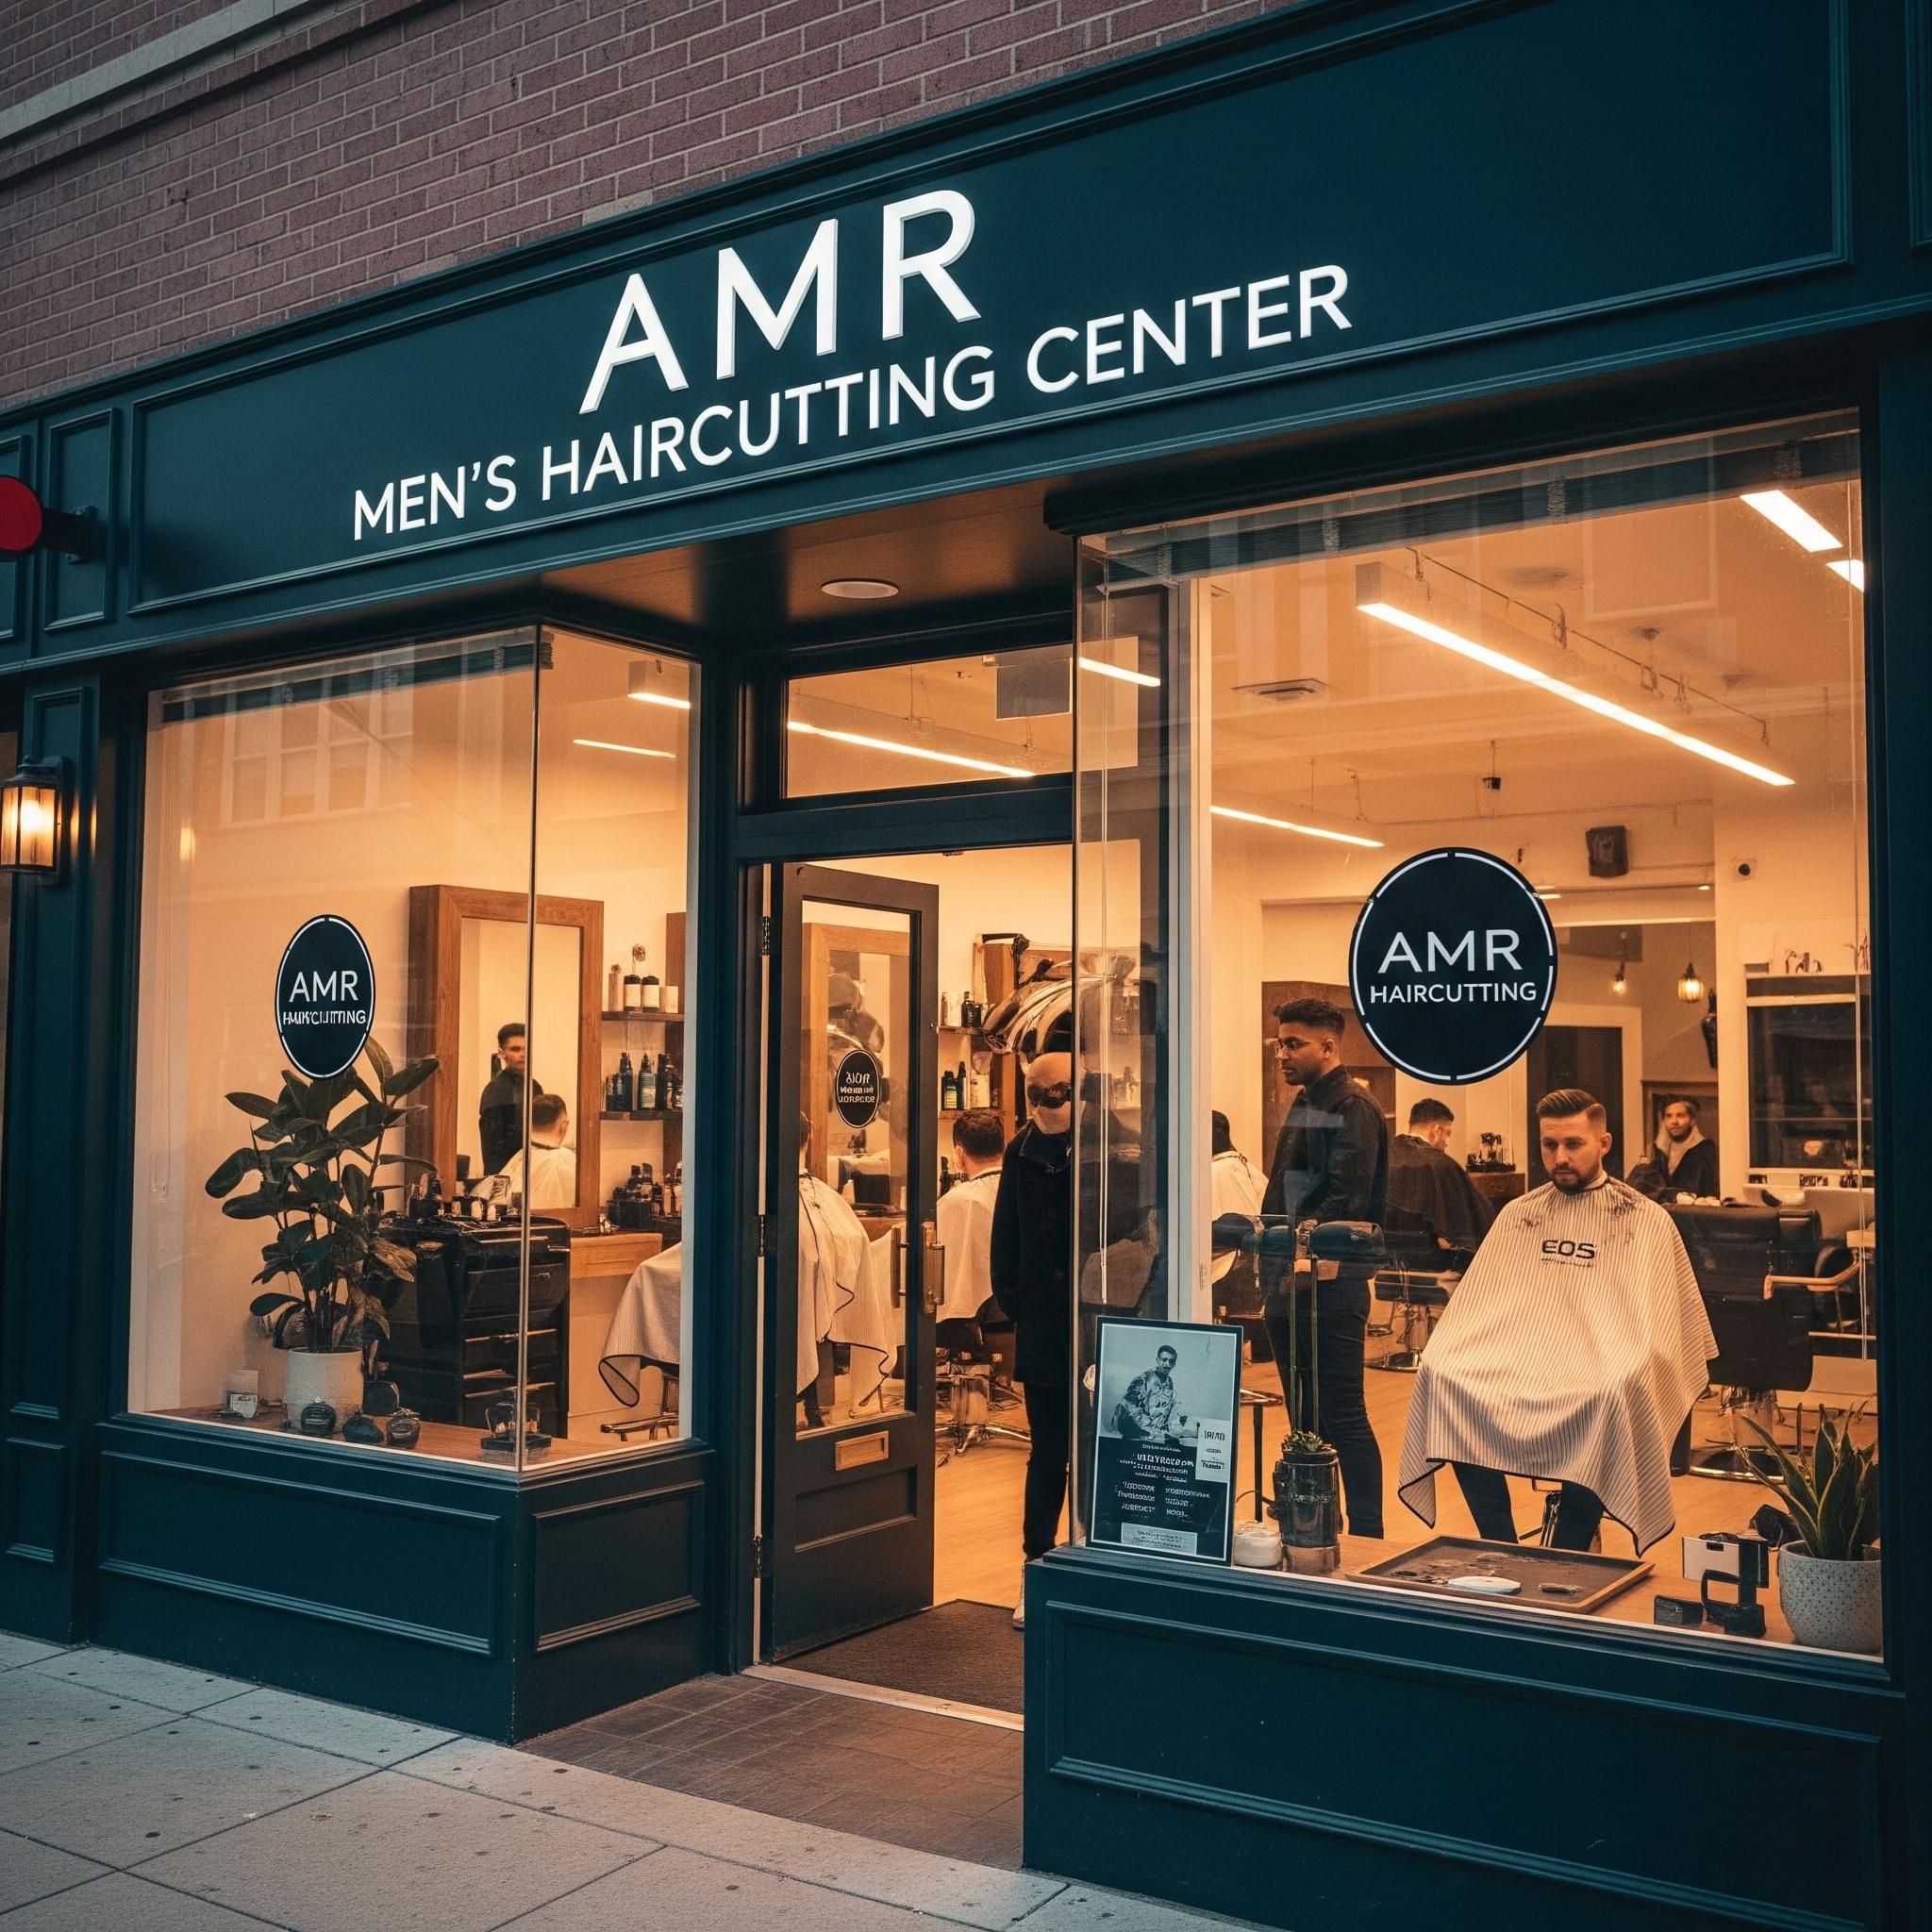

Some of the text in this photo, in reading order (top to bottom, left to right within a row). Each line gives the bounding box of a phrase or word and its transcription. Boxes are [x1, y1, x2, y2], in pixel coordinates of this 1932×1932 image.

[579, 190, 981, 414] AMR
[354, 265, 1353, 541] MEN’S HAIRCUTTING CENTER
[1377, 928, 1523, 974] AMR
[289, 970, 358, 1003] AMR
[1370, 981, 1537, 1004] HAIRCUTTING
[1541, 1240, 1595, 1259] EOS
